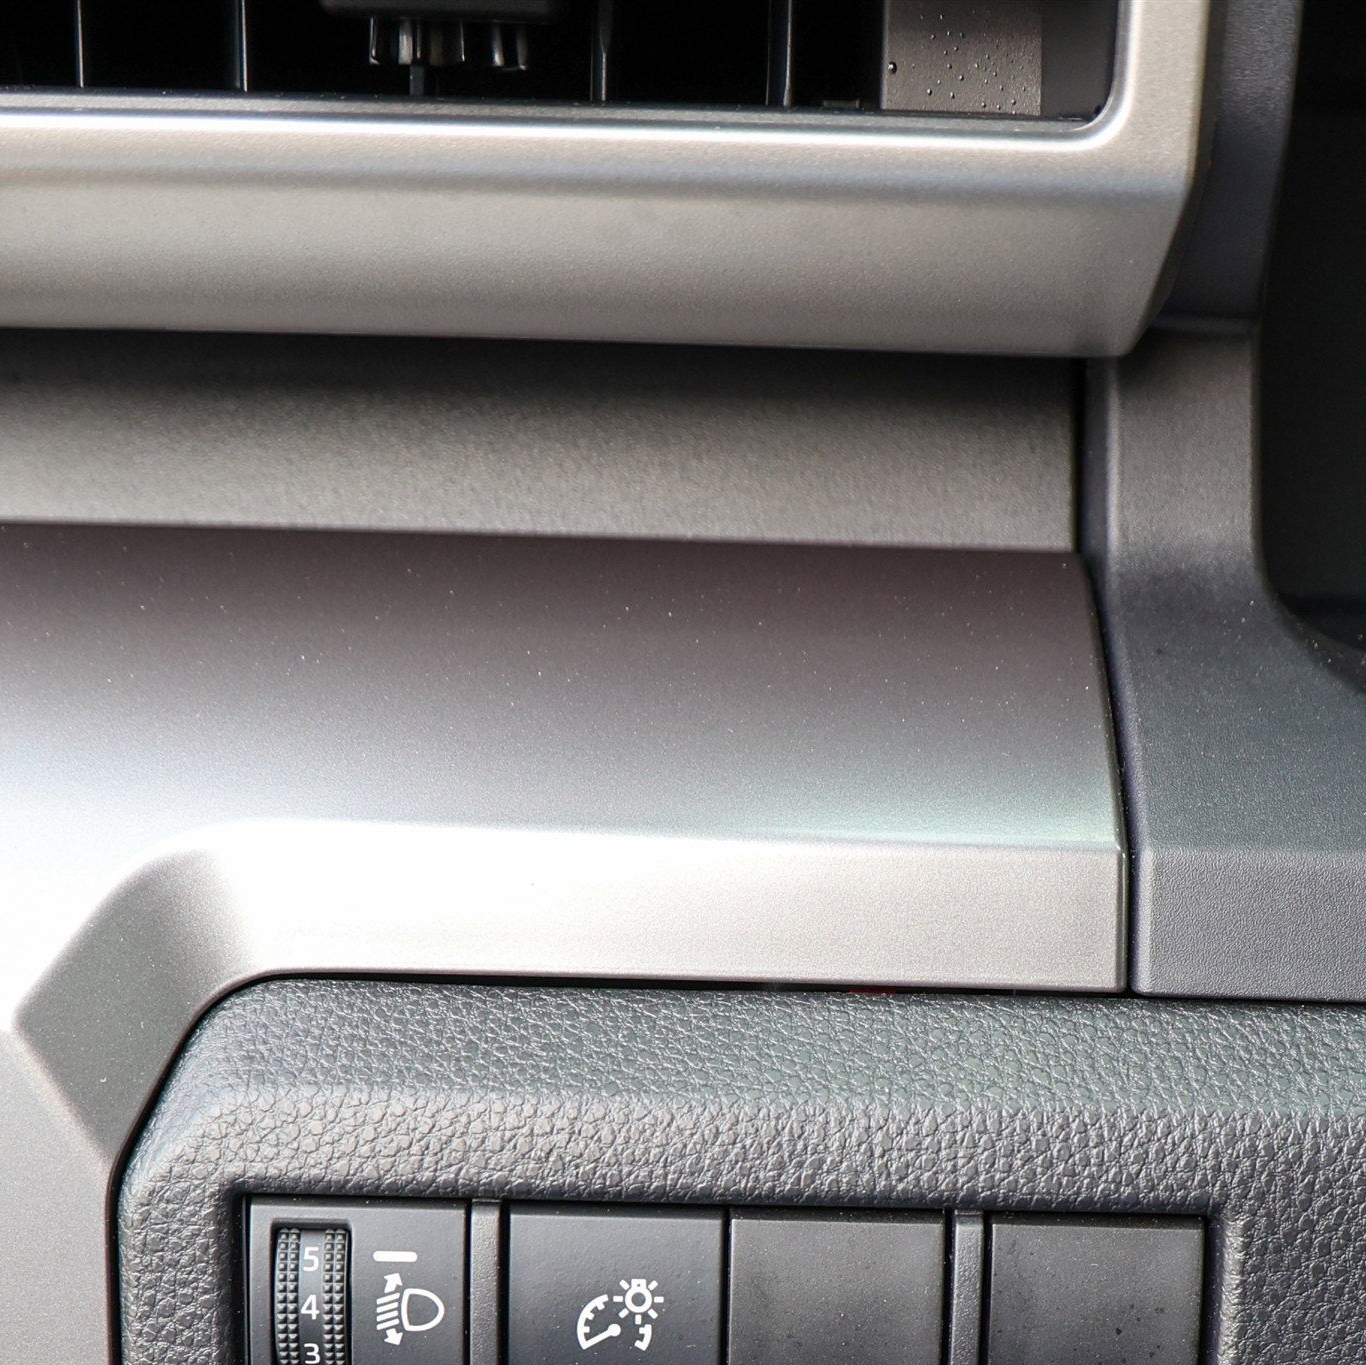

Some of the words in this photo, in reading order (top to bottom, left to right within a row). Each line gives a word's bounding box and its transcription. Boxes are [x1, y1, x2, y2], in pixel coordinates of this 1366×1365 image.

[303, 1246, 319, 1272] 5
[300, 1294, 320, 1320] 4
[303, 1342, 321, 1364] 3
